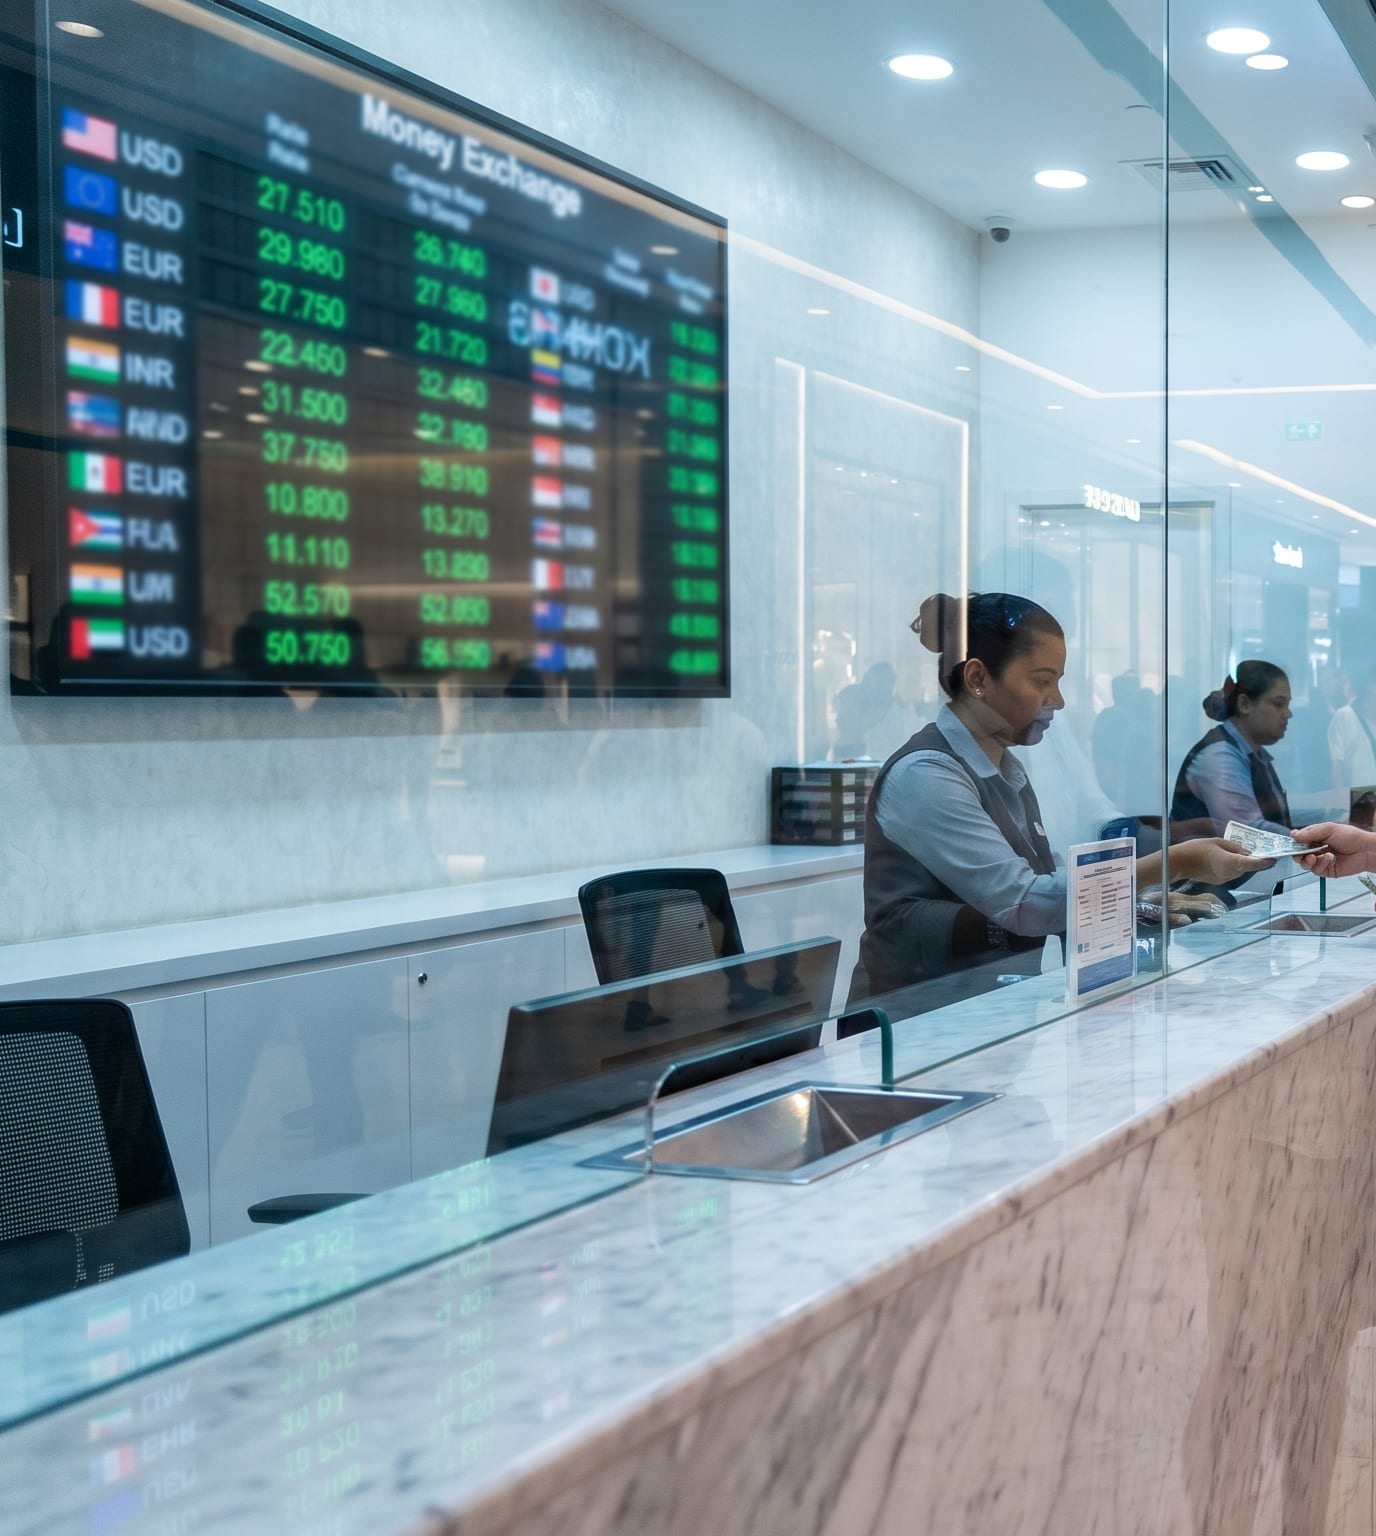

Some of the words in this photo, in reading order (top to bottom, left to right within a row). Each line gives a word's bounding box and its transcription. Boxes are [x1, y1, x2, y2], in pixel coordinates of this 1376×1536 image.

[120, 130, 183, 177] USD
[257, 176, 345, 233] 27.510
[361, 92, 455, 172] Money
[461, 135, 583, 220] Exchange
[121, 186, 183, 231] USD
[258, 227, 345, 281] 29.980
[122, 241, 183, 285] EUR
[259, 278, 346, 329] 27.750
[123, 298, 184, 339] EUR
[125, 353, 175, 389] INR
[261, 380, 348, 425] 31.500
[262, 429, 349, 474] 37.750
[126, 461, 188, 498] EUR
[264, 482, 349, 522] 10.800
[265, 531, 350, 570] 11.110
[264, 580, 350, 618] 52.570
[129, 626, 189, 659] USD
[264, 630, 351, 666] 50.750
